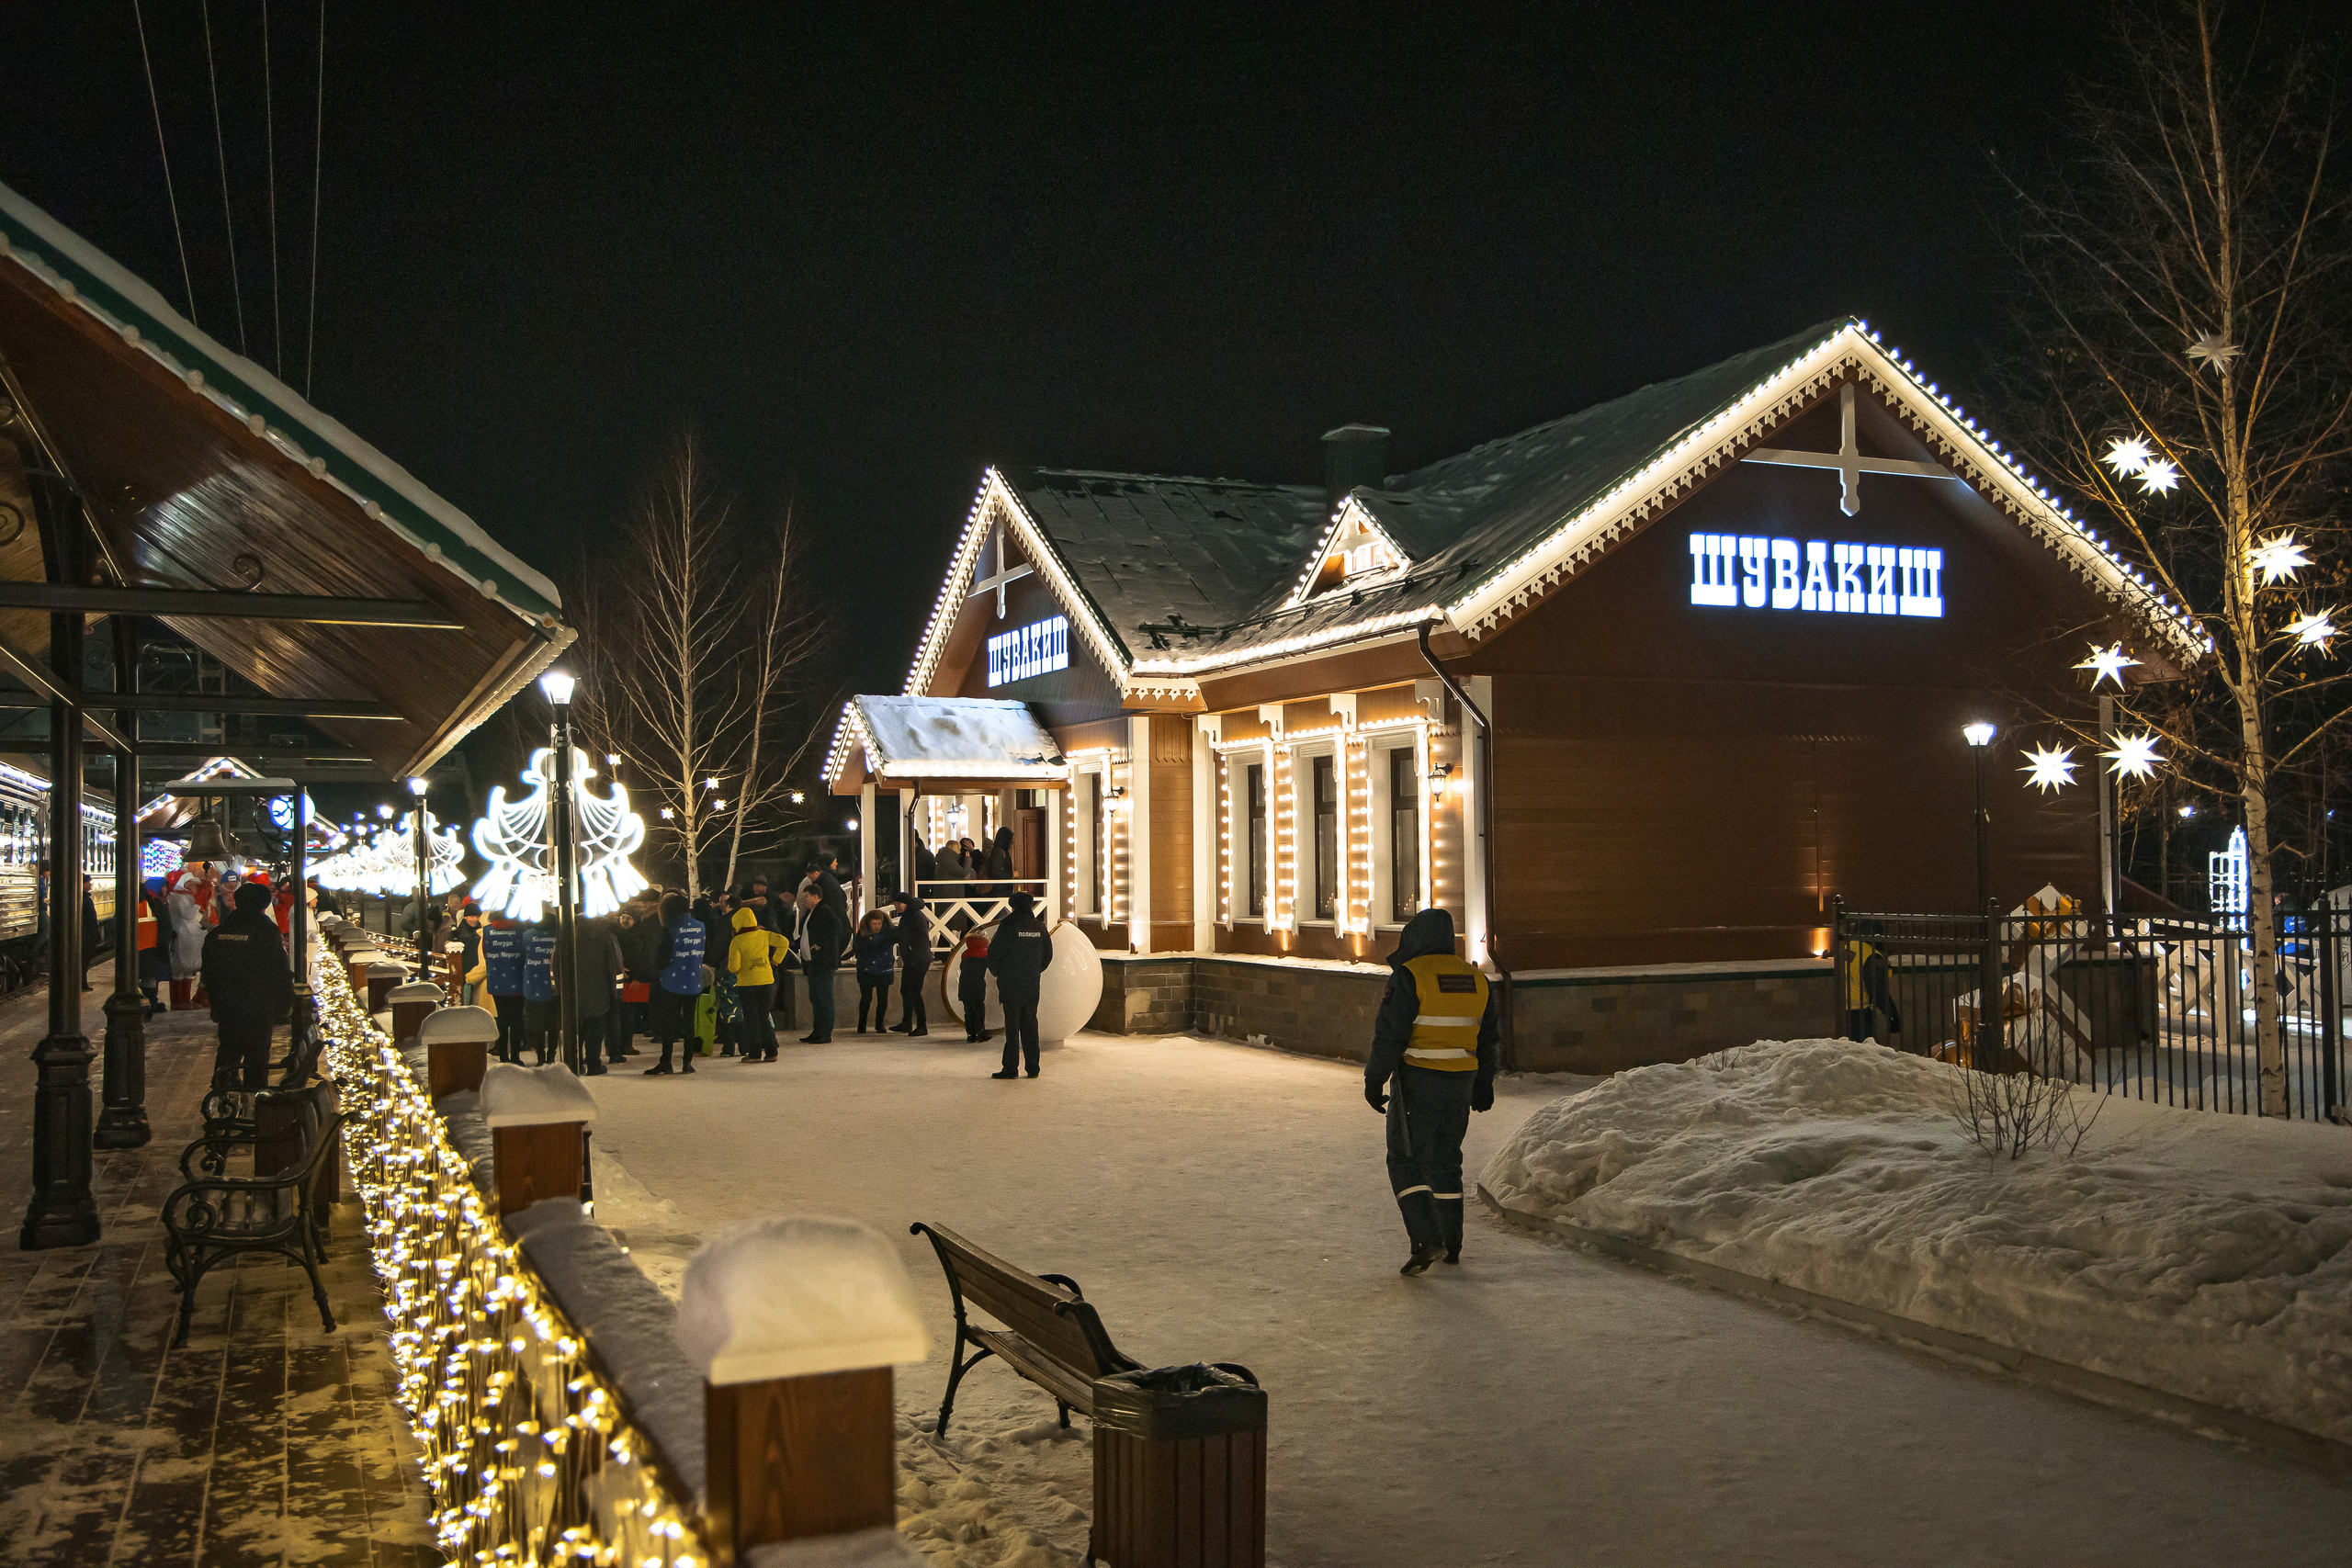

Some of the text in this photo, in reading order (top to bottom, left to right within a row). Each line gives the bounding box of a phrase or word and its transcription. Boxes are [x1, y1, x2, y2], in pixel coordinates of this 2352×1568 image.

[1690, 532, 1944, 618] ШУВАКИШ
[988, 615, 1069, 688] ШУВАКИШ
[492, 940, 514, 948] Поезда
